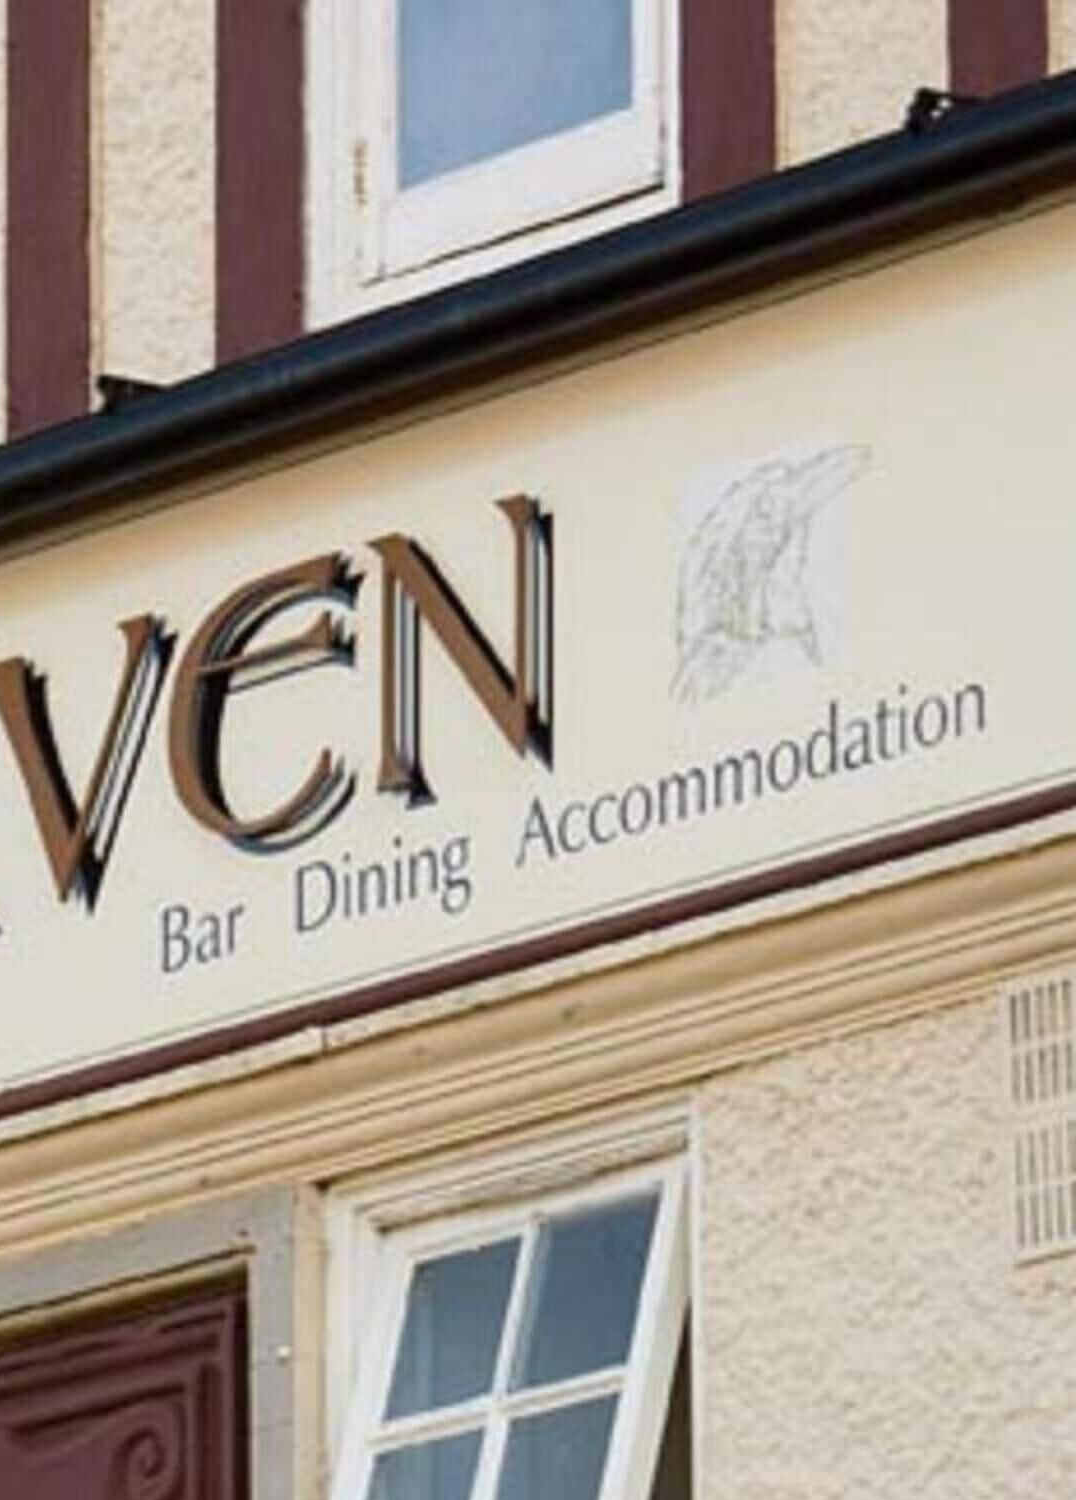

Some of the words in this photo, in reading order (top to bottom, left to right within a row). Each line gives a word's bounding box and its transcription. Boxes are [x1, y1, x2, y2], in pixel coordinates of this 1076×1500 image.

[160, 898, 245, 973] Bar
[295, 833, 472, 914] Dining
[515, 682, 987, 867] Accommodation
